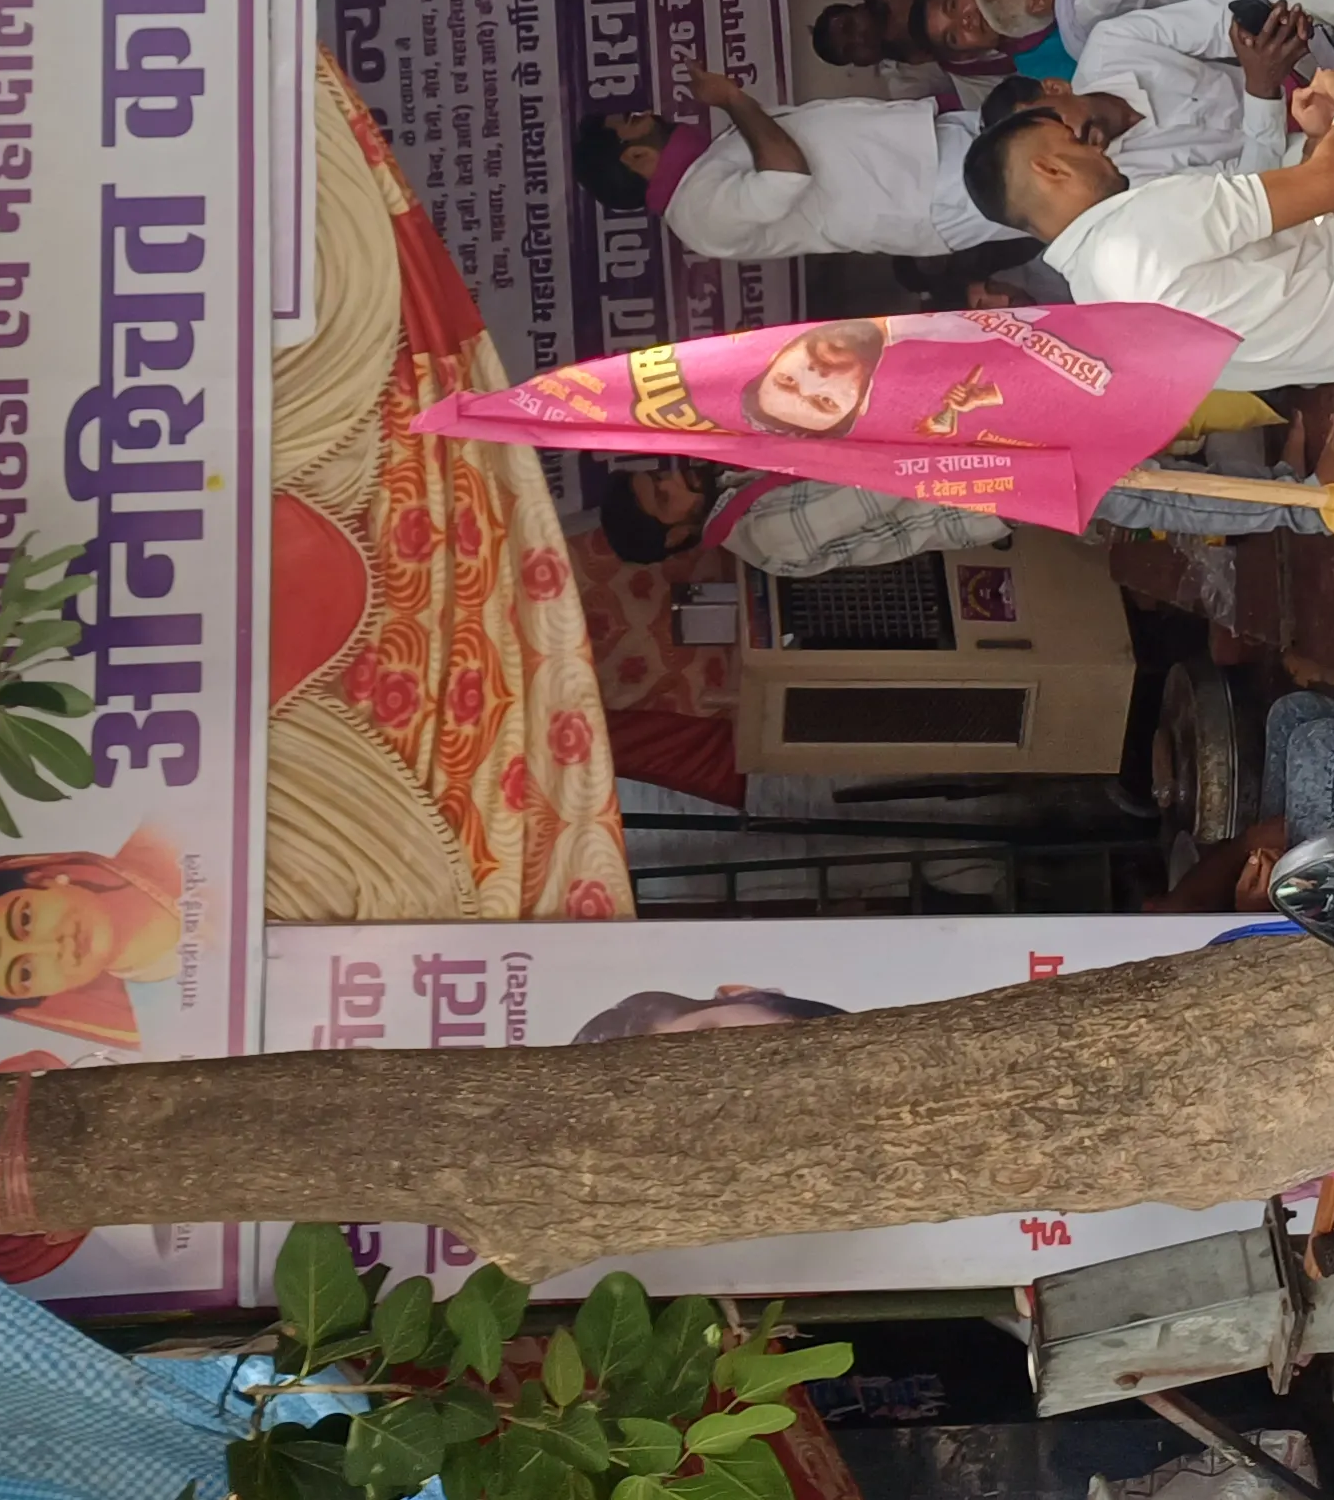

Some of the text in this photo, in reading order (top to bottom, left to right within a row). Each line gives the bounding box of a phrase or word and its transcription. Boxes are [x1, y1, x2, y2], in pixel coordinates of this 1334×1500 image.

[510, 60, 542, 86] के
[515, 94, 549, 195] आरक्षण
[521, 201, 557, 323] महादलित
[526, 329, 558, 368] एवं
[61, 182, 208, 789] अनिश्चित
[893, 456, 930, 476] जय
[173, 898, 200, 1011] सावित्री बाई
